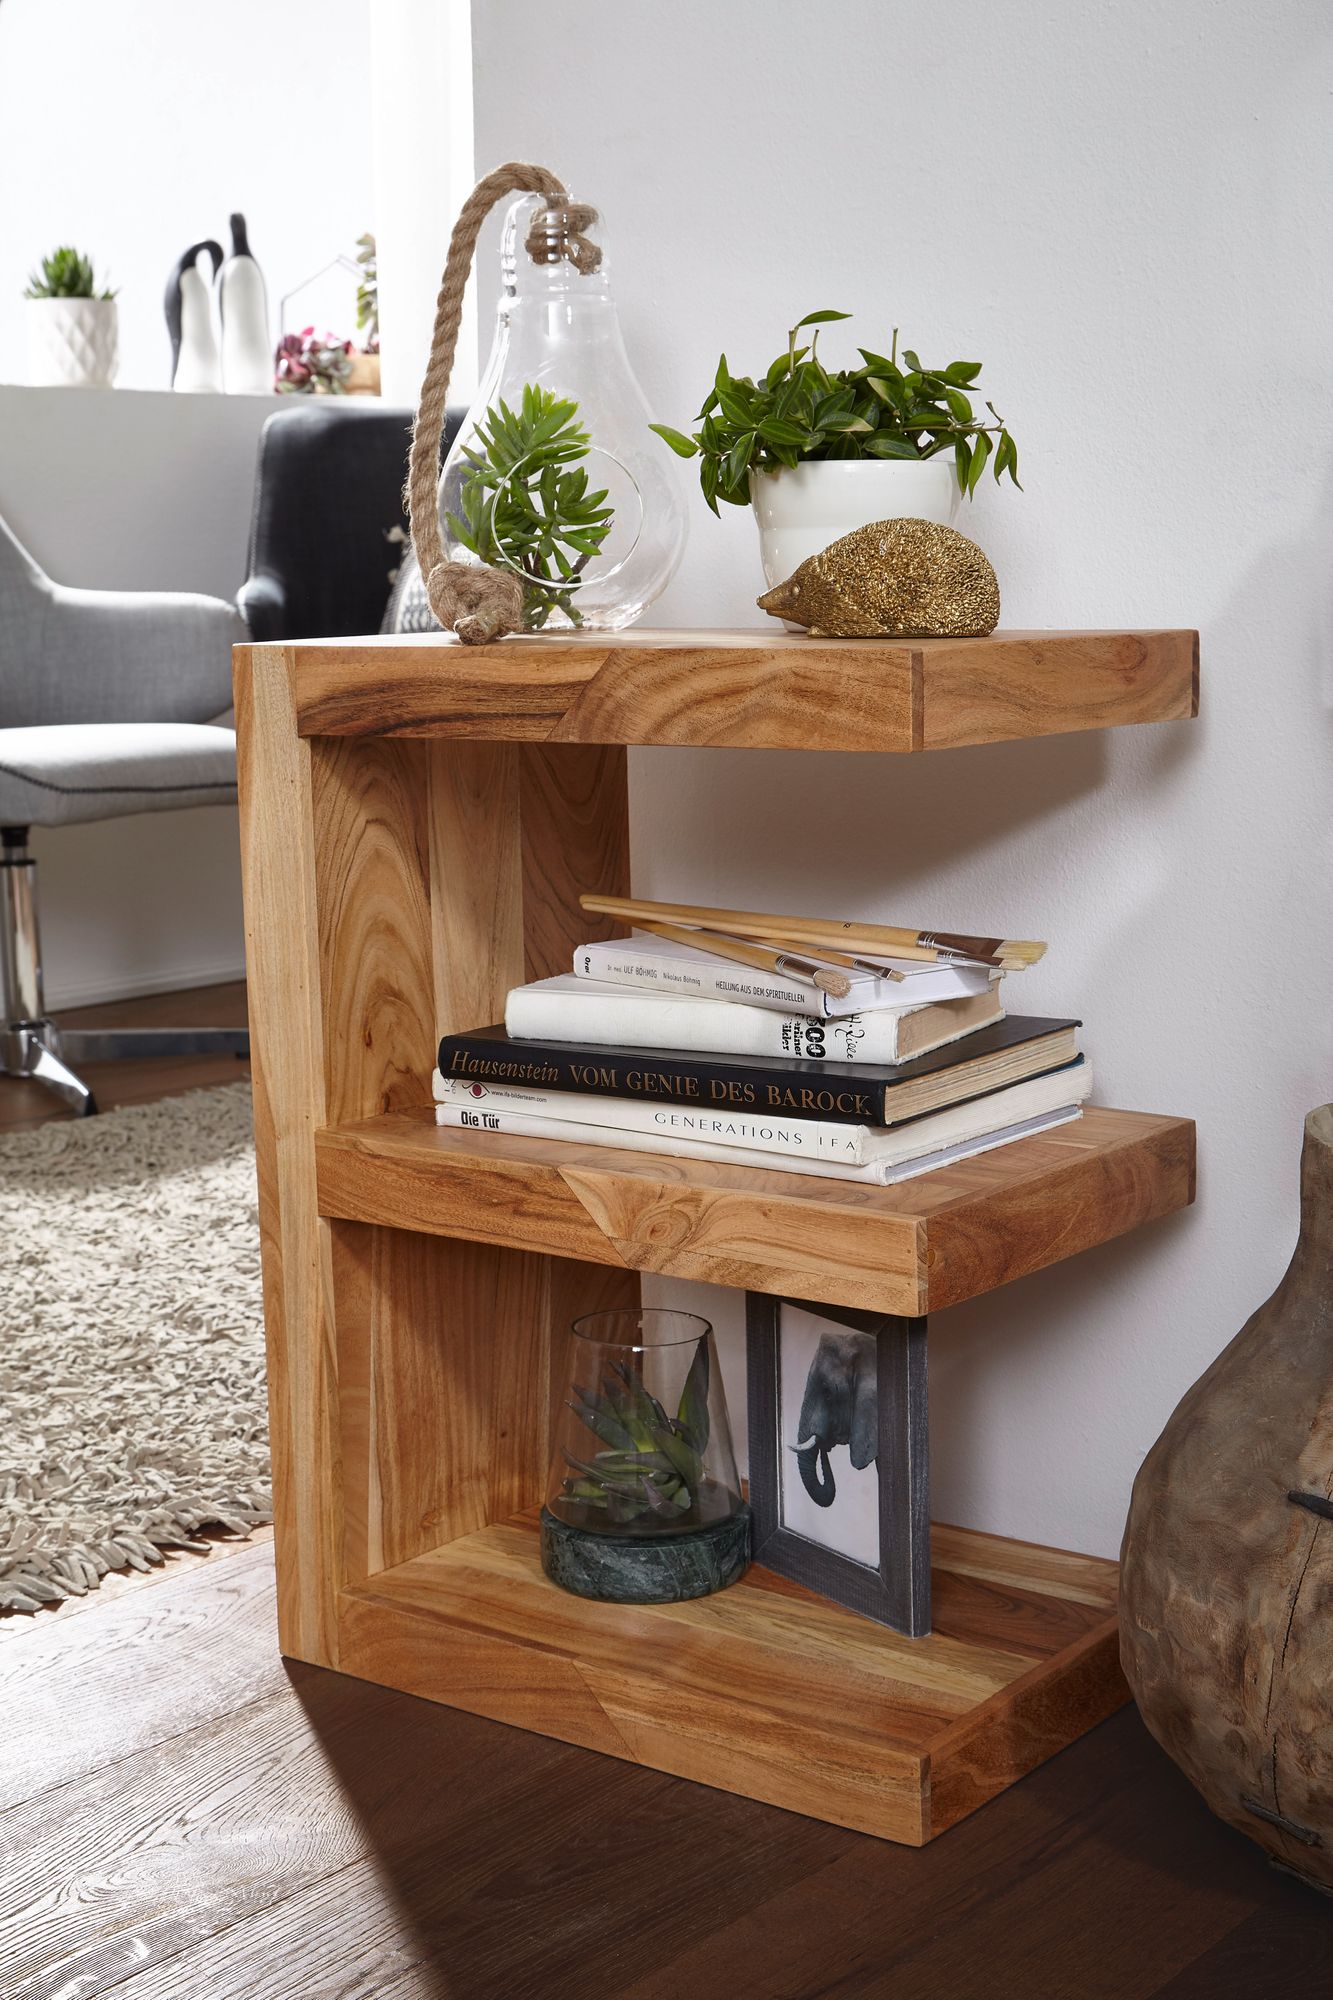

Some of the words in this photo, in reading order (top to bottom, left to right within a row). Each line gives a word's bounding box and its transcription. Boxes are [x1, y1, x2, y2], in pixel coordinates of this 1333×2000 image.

[623, 965, 634, 975] ULF
[662, 972, 682, 982] Nikolaus
[715, 980, 740, 993] HEILUNG
[740, 984, 752, 995] AUS
[752, 986, 765, 997] DEM
[765, 988, 805, 1003] SPIRITUELLEN
[450, 1049, 560, 1082] Hausenstein
[568, 1064, 619, 1088] VOM
[626, 1071, 700, 1098] GENIE
[710, 1079, 756, 1104] DES
[766, 1084, 872, 1116] BAROCK
[491, 1090, 548, 1103] www.ifa-bilderteam.com
[461, 1111, 480, 1127] Die
[481, 1113, 500, 1129] Tür
[654, 1112, 803, 1145] GENERATIONS
